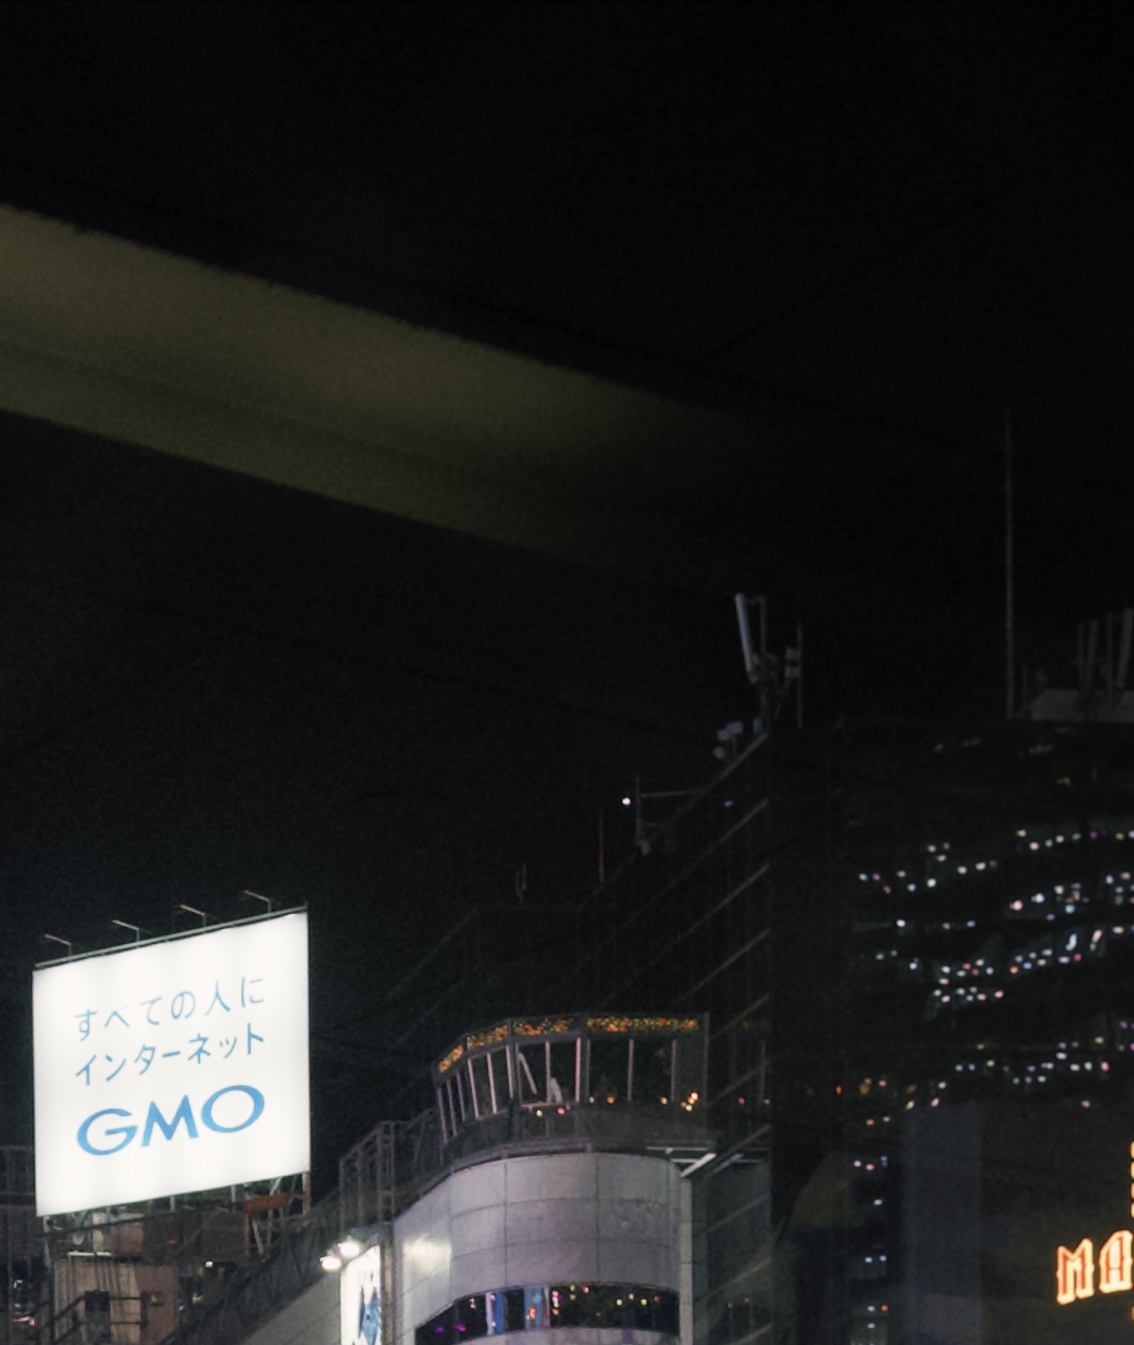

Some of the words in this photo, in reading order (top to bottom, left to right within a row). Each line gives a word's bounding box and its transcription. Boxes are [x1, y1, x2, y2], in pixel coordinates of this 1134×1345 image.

[74, 977, 265, 1042] すべての人に
[75, 1022, 264, 1086] インターネット
[76, 1084, 266, 1156] GMO
